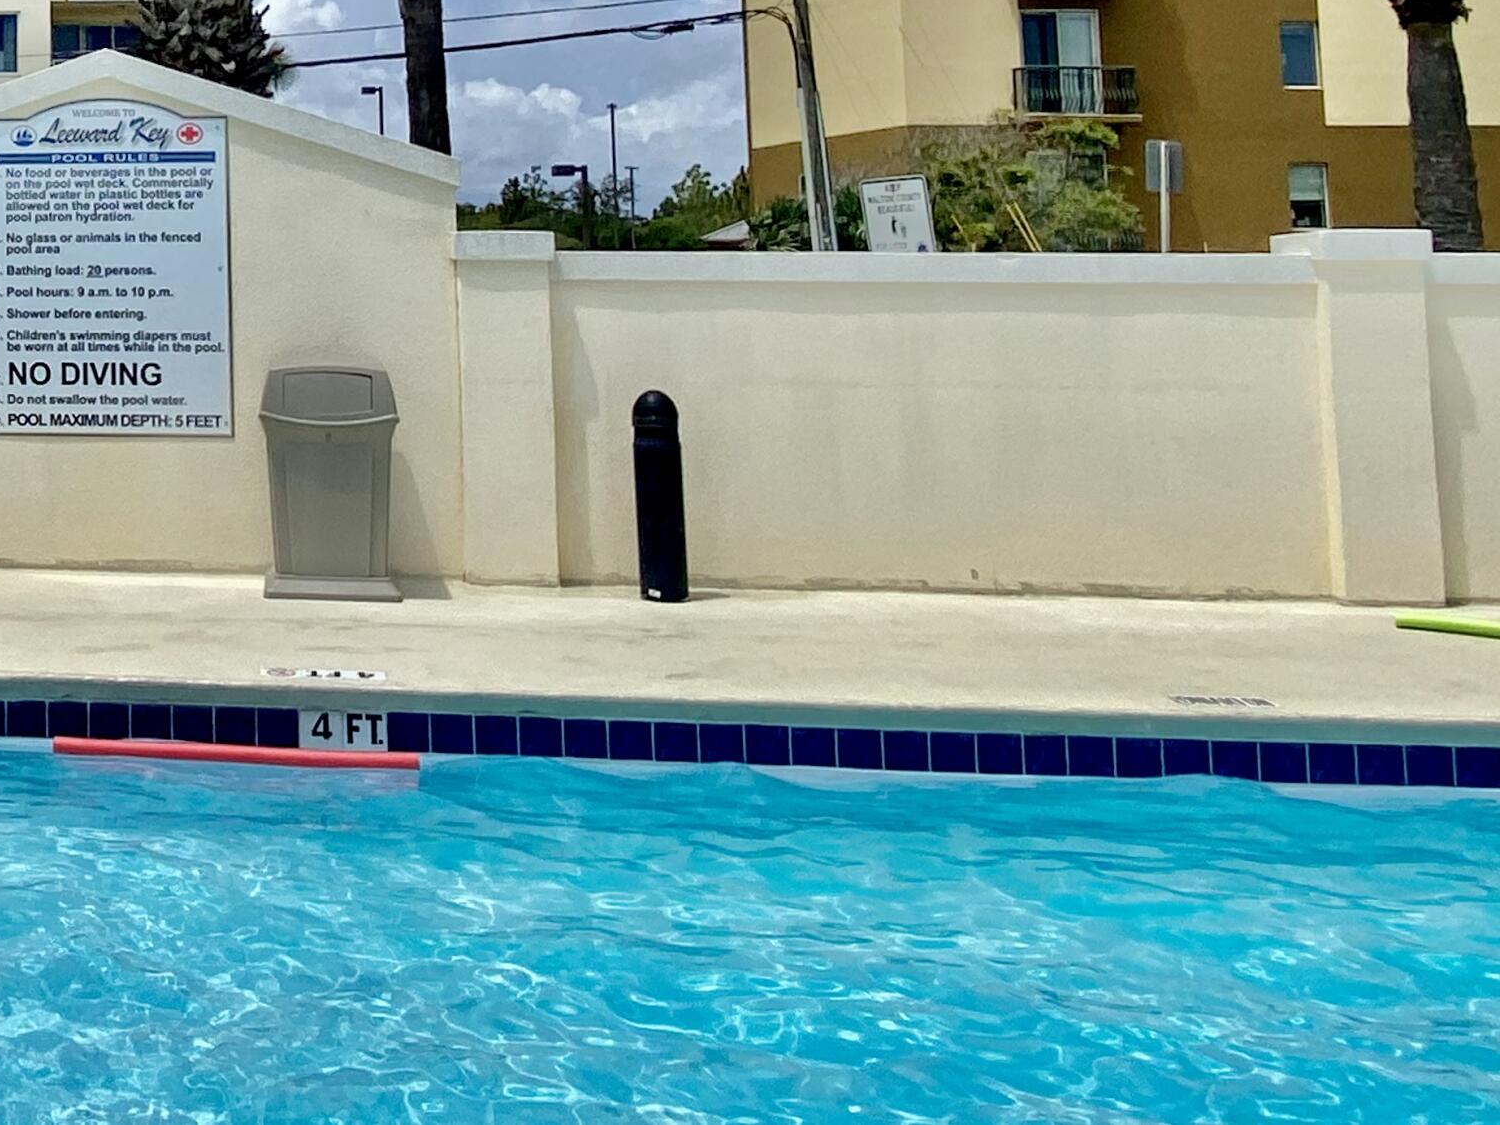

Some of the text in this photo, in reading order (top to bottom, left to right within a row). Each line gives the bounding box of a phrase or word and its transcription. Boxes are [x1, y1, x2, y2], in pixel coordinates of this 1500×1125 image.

[72, 109, 135, 117] WELCOME TO
[39, 117, 170, 148] Leeward Key
[51, 153, 159, 163] POOL RULES
[6, 168, 22, 177] No
[25, 168, 51, 177] food
[55, 169, 66, 177] or
[71, 168, 130, 179] beverages
[134, 168, 146, 176] in
[149, 168, 167, 176] the
[171, 168, 197, 178] pool
[201, 168, 212, 176] or
[6, 179, 213, 191] on the pool wet deck. Commercially
[6, 191, 46, 200] bottled
[85, 190, 95, 199] in
[100, 190, 137, 201] plastic
[141, 190, 180, 199] bottles
[6, 202, 50, 211] allowed
[72, 201, 91, 210] the
[94, 201, 120, 212] pool
[123, 201, 144, 210] wet
[147, 201, 175, 210] deck
[178, 201, 194, 210] for
[6, 212, 134, 225] pool patron hydration.
[6, 233, 23, 243] No
[26, 233, 57, 245] glass
[60, 235, 72, 243] or
[76, 233, 121, 243] animals
[124, 233, 136, 242] in
[140, 233, 158, 242] the
[161, 233, 201, 242] fenced
[6, 245, 60, 256] pool area
[7, 266, 51, 277] Bathing
[55, 266, 84, 275] load:
[86, 266, 103, 277] 20
[105, 267, 156, 277] persons.
[7, 287, 33, 297] Pool
[37, 287, 73, 297] hours:
[78, 288, 84, 297] 9
[88, 289, 112, 297] a.m.
[116, 288, 127, 297] to
[132, 288, 145, 297] 10
[149, 289, 173, 300] p.m.
[7, 309, 50, 319] Shower
[54, 308, 91, 319] before
[95, 309, 147, 321] entering.
[7, 331, 65, 341] Children's
[70, 331, 130, 342] swimming
[134, 331, 177, 342] diapers
[181, 332, 211, 341] must
[7, 342, 224, 354] be worn at all times while in the pool.
[9, 362, 51, 385] NO
[61, 362, 162, 386] DIVING
[7, 395, 23, 405] Do
[27, 396, 47, 405] not
[50, 395, 96, 405] swallow
[100, 395, 118, 405] the
[122, 395, 148, 408] pool
[152, 397, 187, 405] water.
[8, 414, 47, 426] POOL
[51, 414, 118, 426] MAXIMUM
[121, 415, 172, 427] DEPTH:
[175, 416, 183, 427] 5
[187, 416, 221, 427] FEET
[311, 712, 383, 745] 4 FT.
